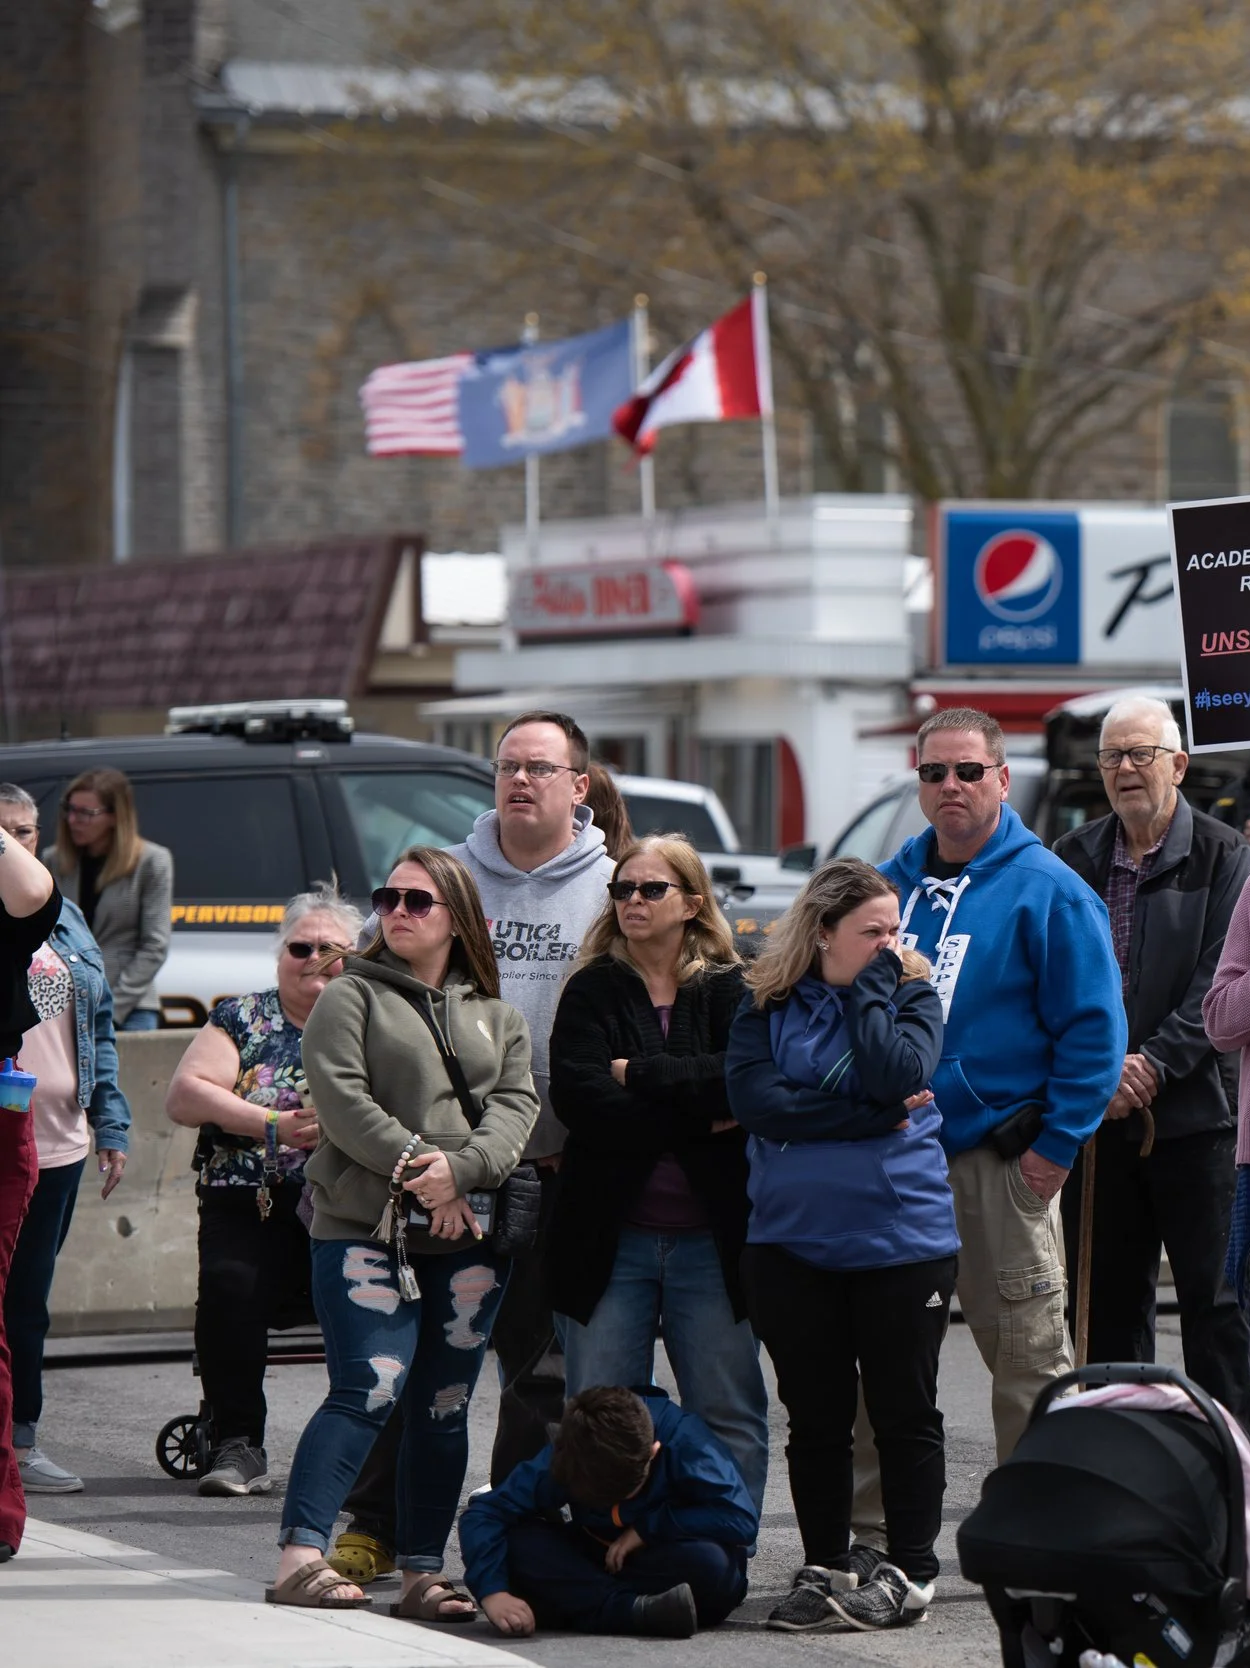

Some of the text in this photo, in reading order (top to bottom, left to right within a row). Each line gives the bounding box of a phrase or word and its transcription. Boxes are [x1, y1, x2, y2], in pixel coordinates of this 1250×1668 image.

[171, 905, 286, 924] PERVISOR
[495, 920, 561, 942] UTICA
[492, 940, 579, 961] BOILER
[499, 970, 526, 981] plier
[529, 972, 558, 981] Since
[934, 938, 960, 1001] SUPP
